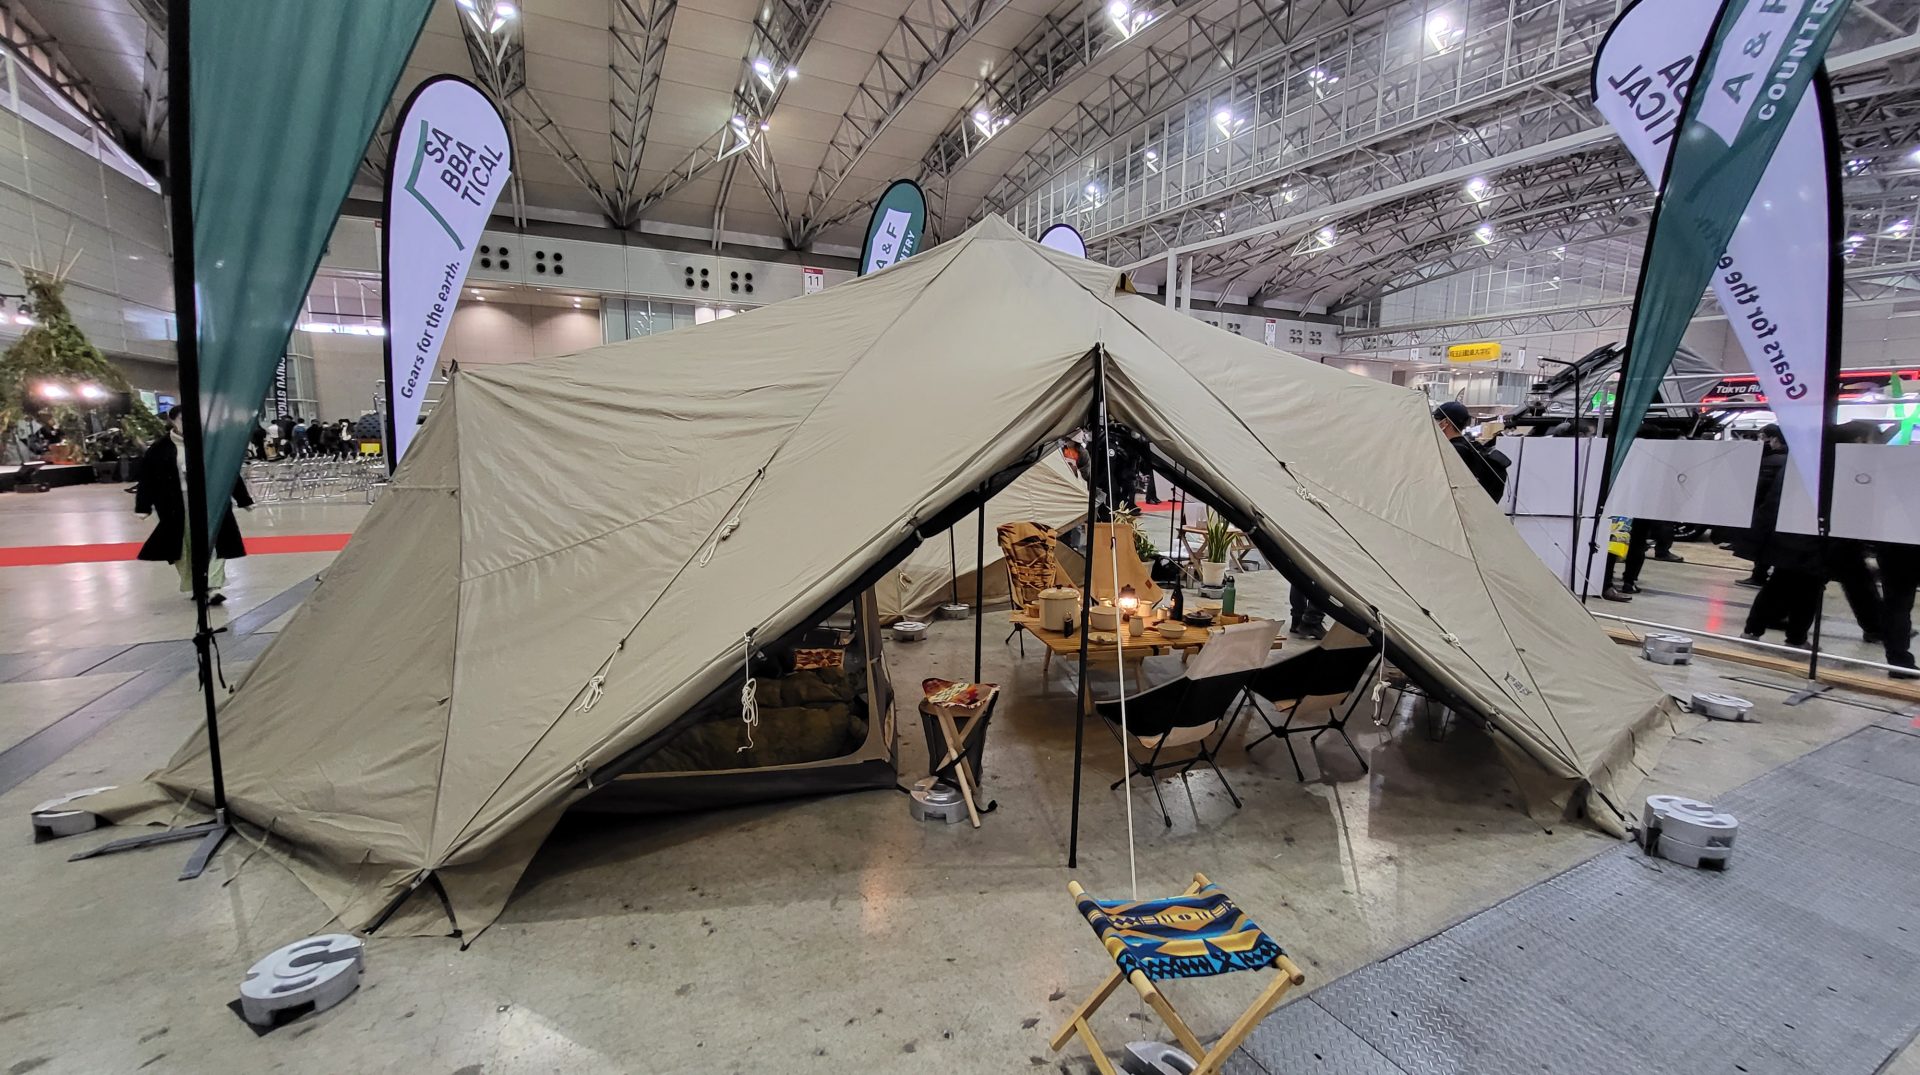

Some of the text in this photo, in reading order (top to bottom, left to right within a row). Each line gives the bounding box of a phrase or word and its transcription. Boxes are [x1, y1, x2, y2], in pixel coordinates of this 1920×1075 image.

[1721, 72, 1754, 105] A
[1743, 30, 1772, 58] &
[423, 127, 453, 164] SA
[440, 141, 476, 193] BBA
[460, 145, 503, 207] TICAL
[886, 222, 897, 239] F
[808, 275, 819, 287] 11
[401, 261, 460, 399] Gears for the earth.
